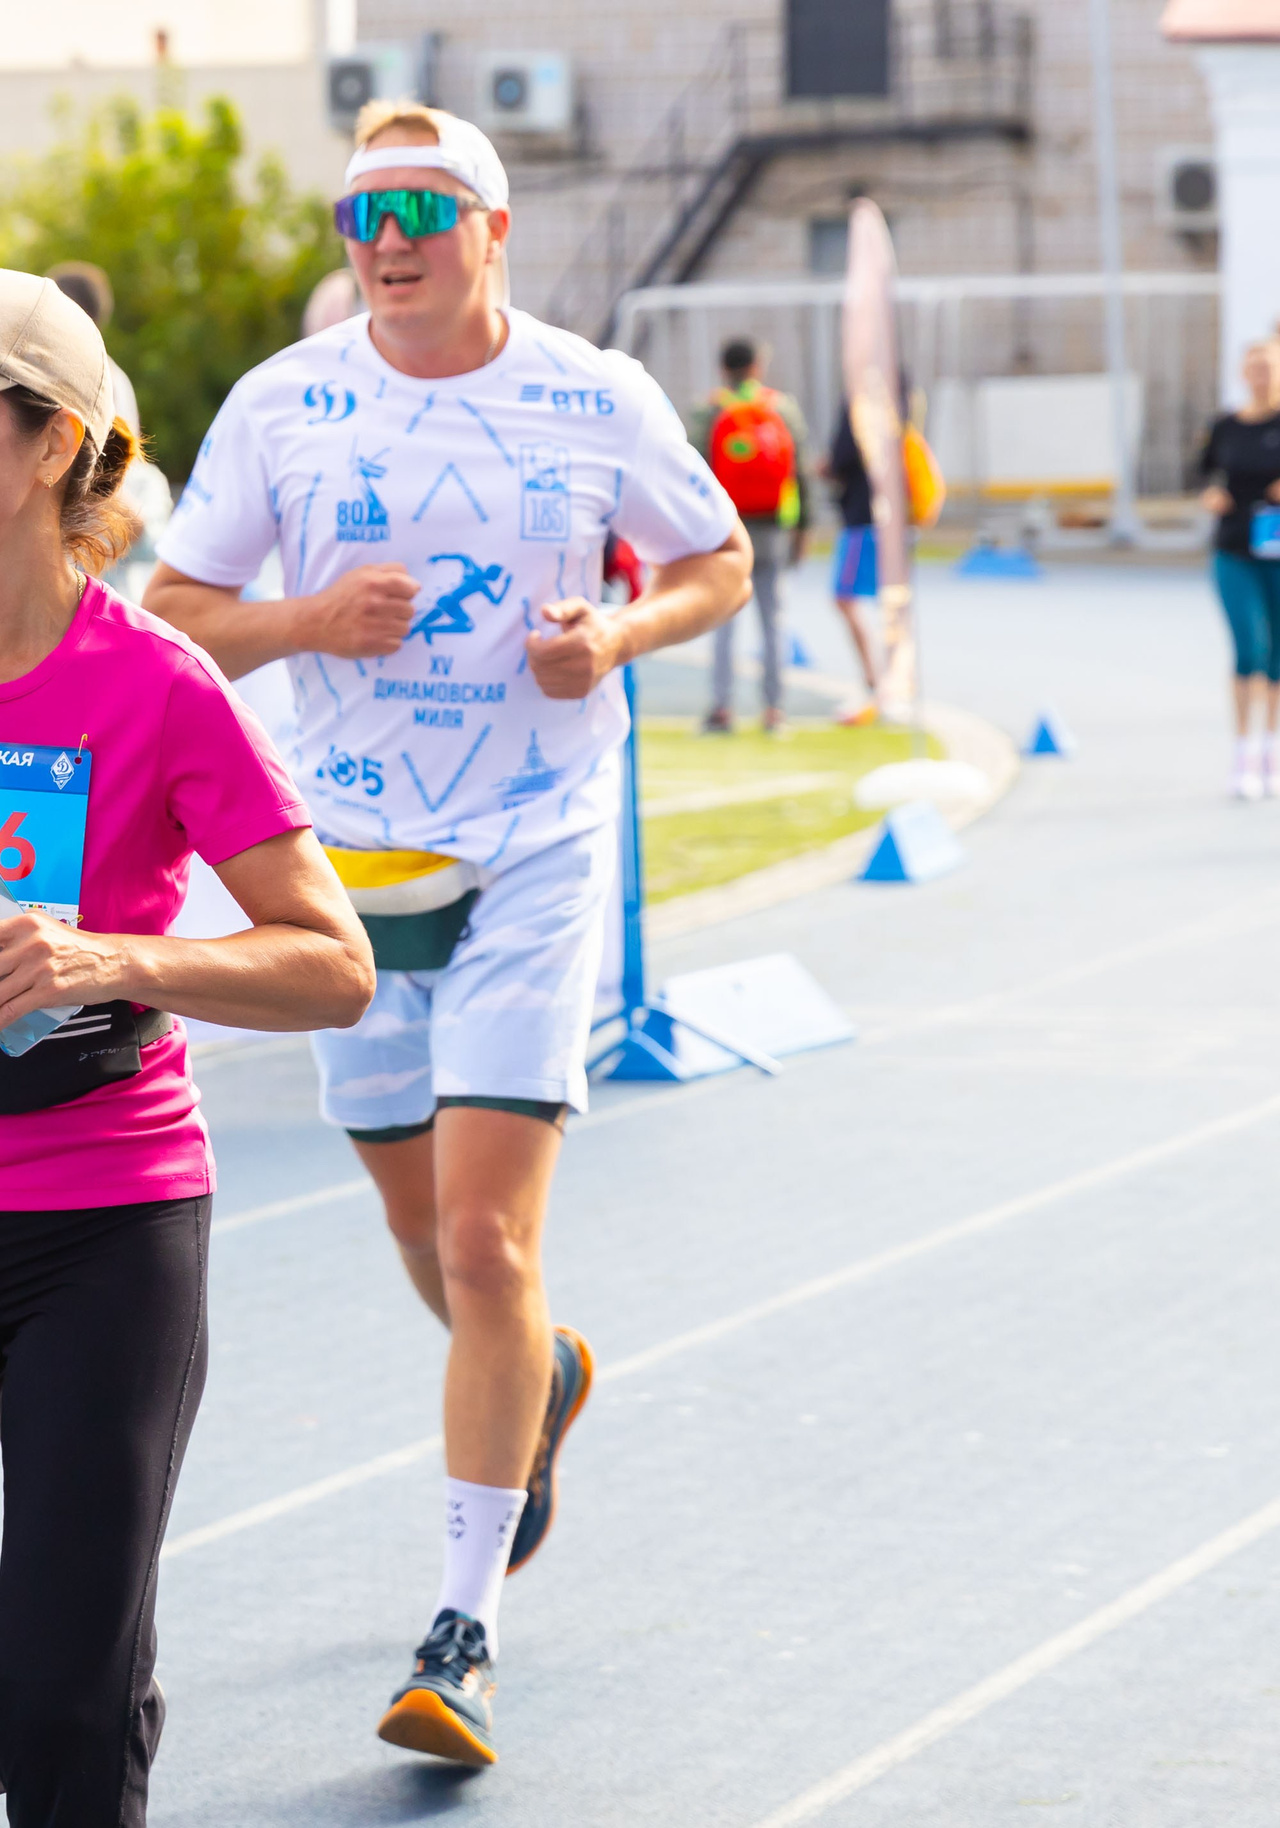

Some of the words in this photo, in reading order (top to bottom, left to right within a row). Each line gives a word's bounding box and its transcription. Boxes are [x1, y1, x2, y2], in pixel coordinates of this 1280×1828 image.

[551, 390, 615, 416] ВТБ
[337, 500, 363, 526] 80
[430, 655, 454, 675] XV
[374, 678, 506, 702] ДИНАМОВСКАЯ
[414, 707, 464, 728] МИЛЯ
